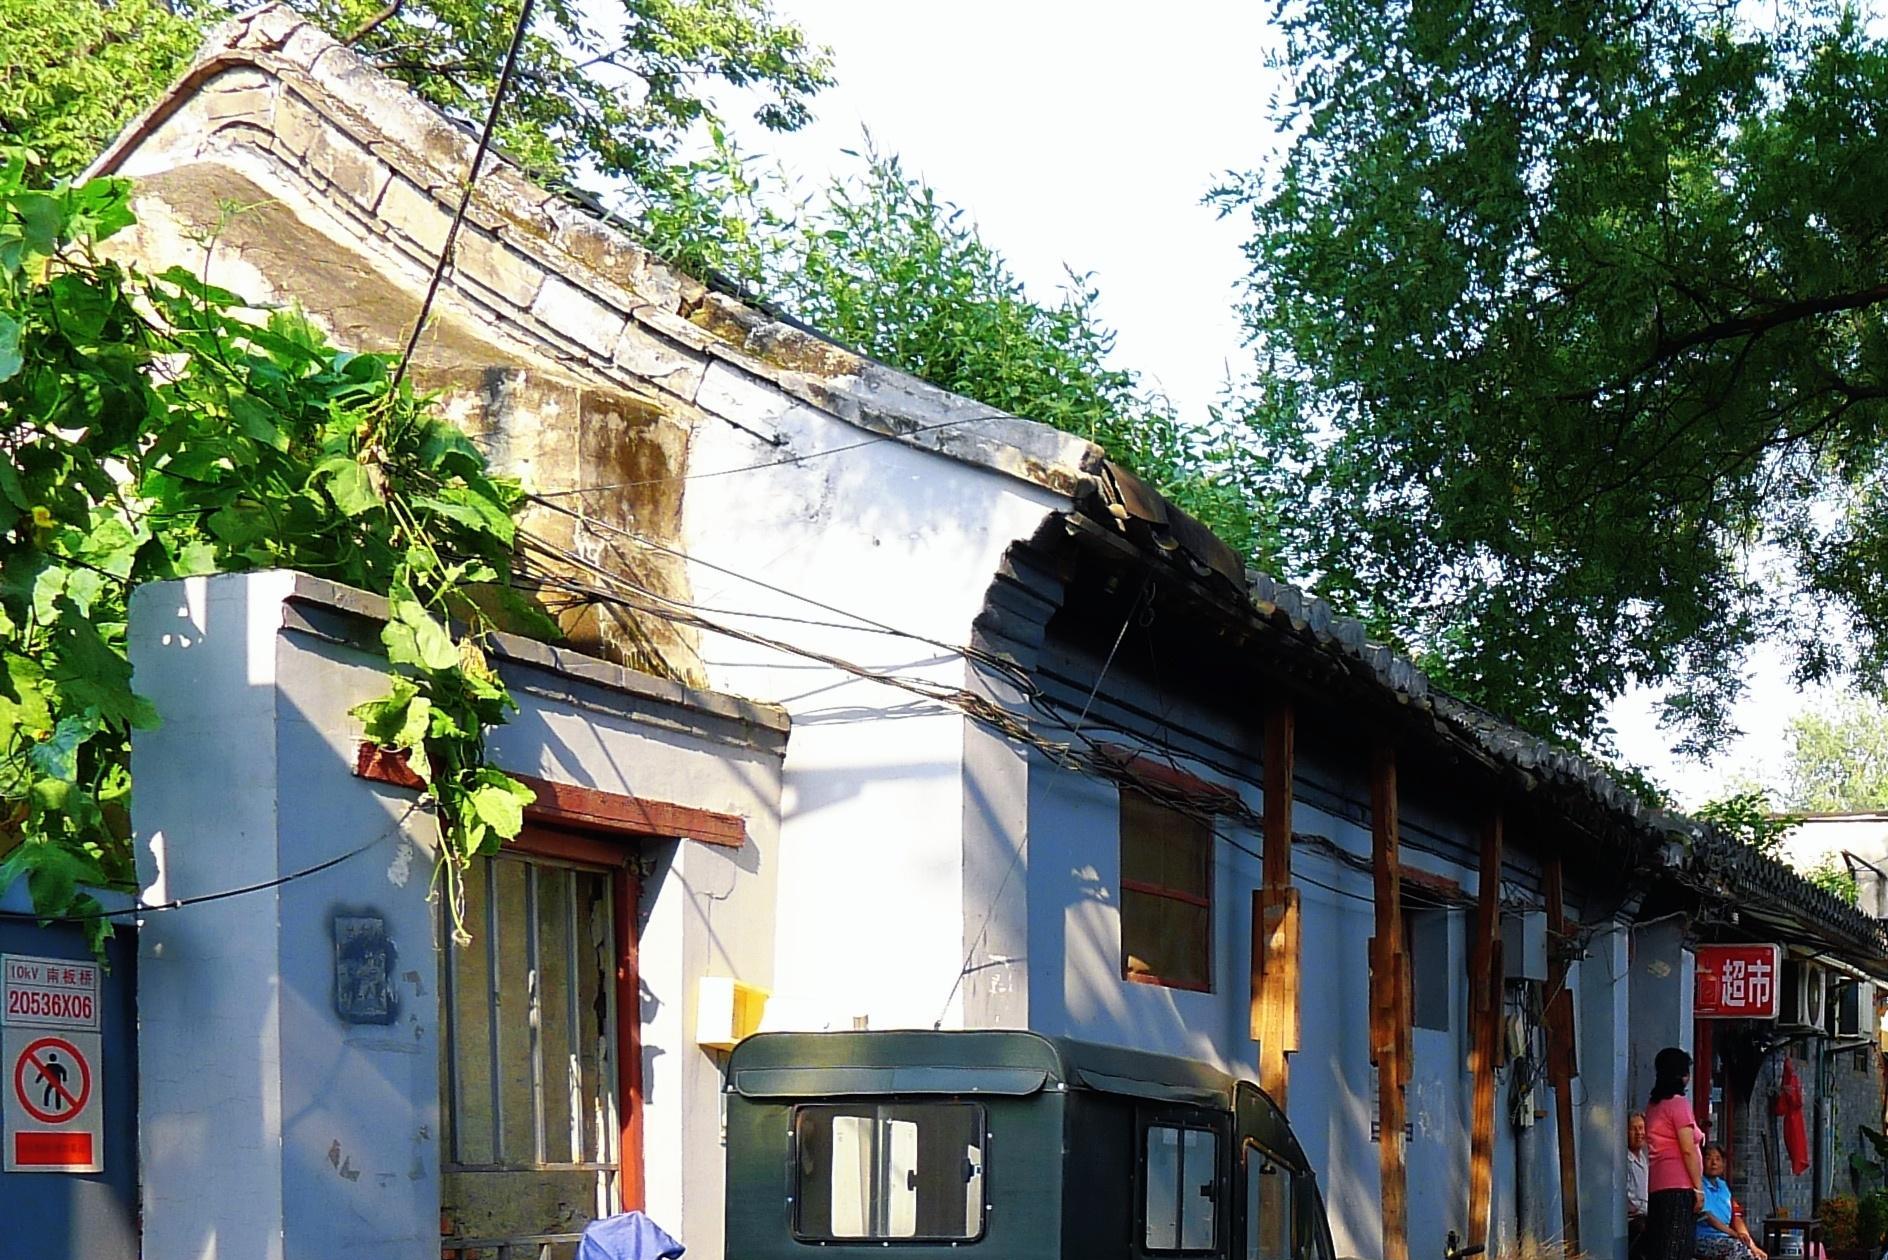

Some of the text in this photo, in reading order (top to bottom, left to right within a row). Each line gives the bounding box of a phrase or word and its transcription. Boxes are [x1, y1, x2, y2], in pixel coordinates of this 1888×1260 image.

[11, 964, 93, 986] 10kV 南板桥
[1721, 958, 1772, 1008] 超市
[9, 990, 93, 1019] 20536X06
